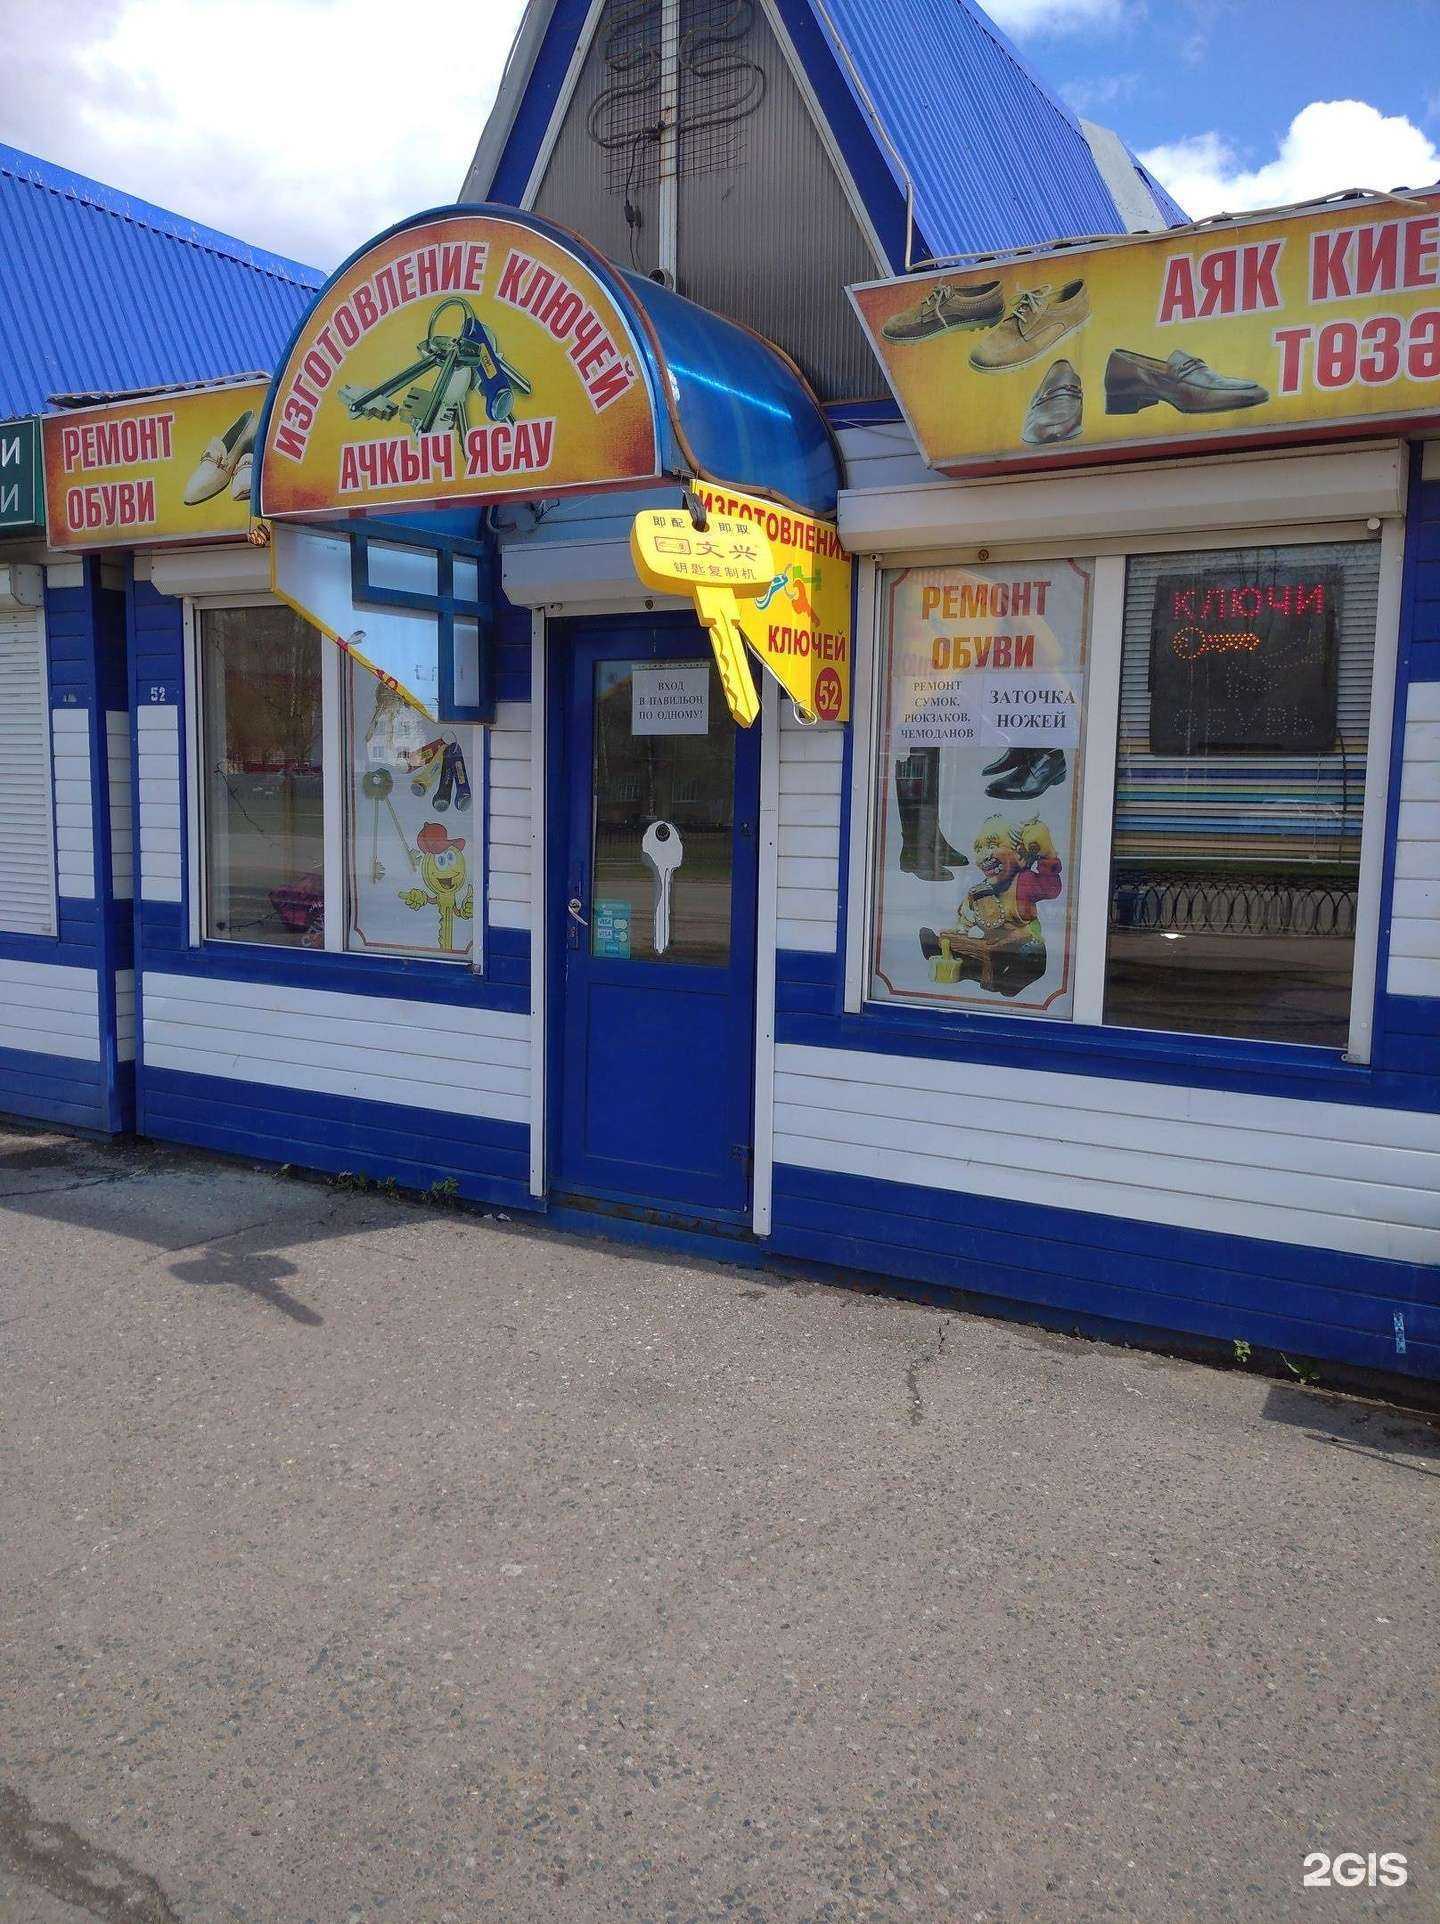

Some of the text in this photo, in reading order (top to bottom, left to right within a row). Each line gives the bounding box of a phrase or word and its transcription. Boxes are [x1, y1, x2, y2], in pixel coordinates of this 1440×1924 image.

[1156, 214, 1440, 327] АЯК КИЕ
[273, 241, 638, 462] ИЗГОТОВЛЕНИЕ КЛЮЧЕЙ
[62, 412, 175, 473] РЕМОНТ
[339, 417, 557, 493] АЧКЫЧ ЯСАУ
[67, 477, 155, 532] ОБУВИ
[921, 581, 1051, 620] РЕМОНТ
[1173, 583, 1325, 619] КЛЮЧИ
[768, 624, 846, 662] КЛЮЧЕЙ
[931, 634, 1035, 670] ОБУВИ
[150, 686, 166, 702] 52
[649, 695, 703, 705] ПАВИЛЬОН
[657, 680, 685, 691] ВХОД
[818, 680, 840, 711] 52
[913, 681, 963, 691] РЕМОНТ
[990, 690, 1077, 704] ЗАТОЧКА
[639, 711, 653, 720] ПО
[996, 711, 1067, 729] НОЖЕЙ
[901, 728, 975, 739] ЧЕМОДАНОВ
